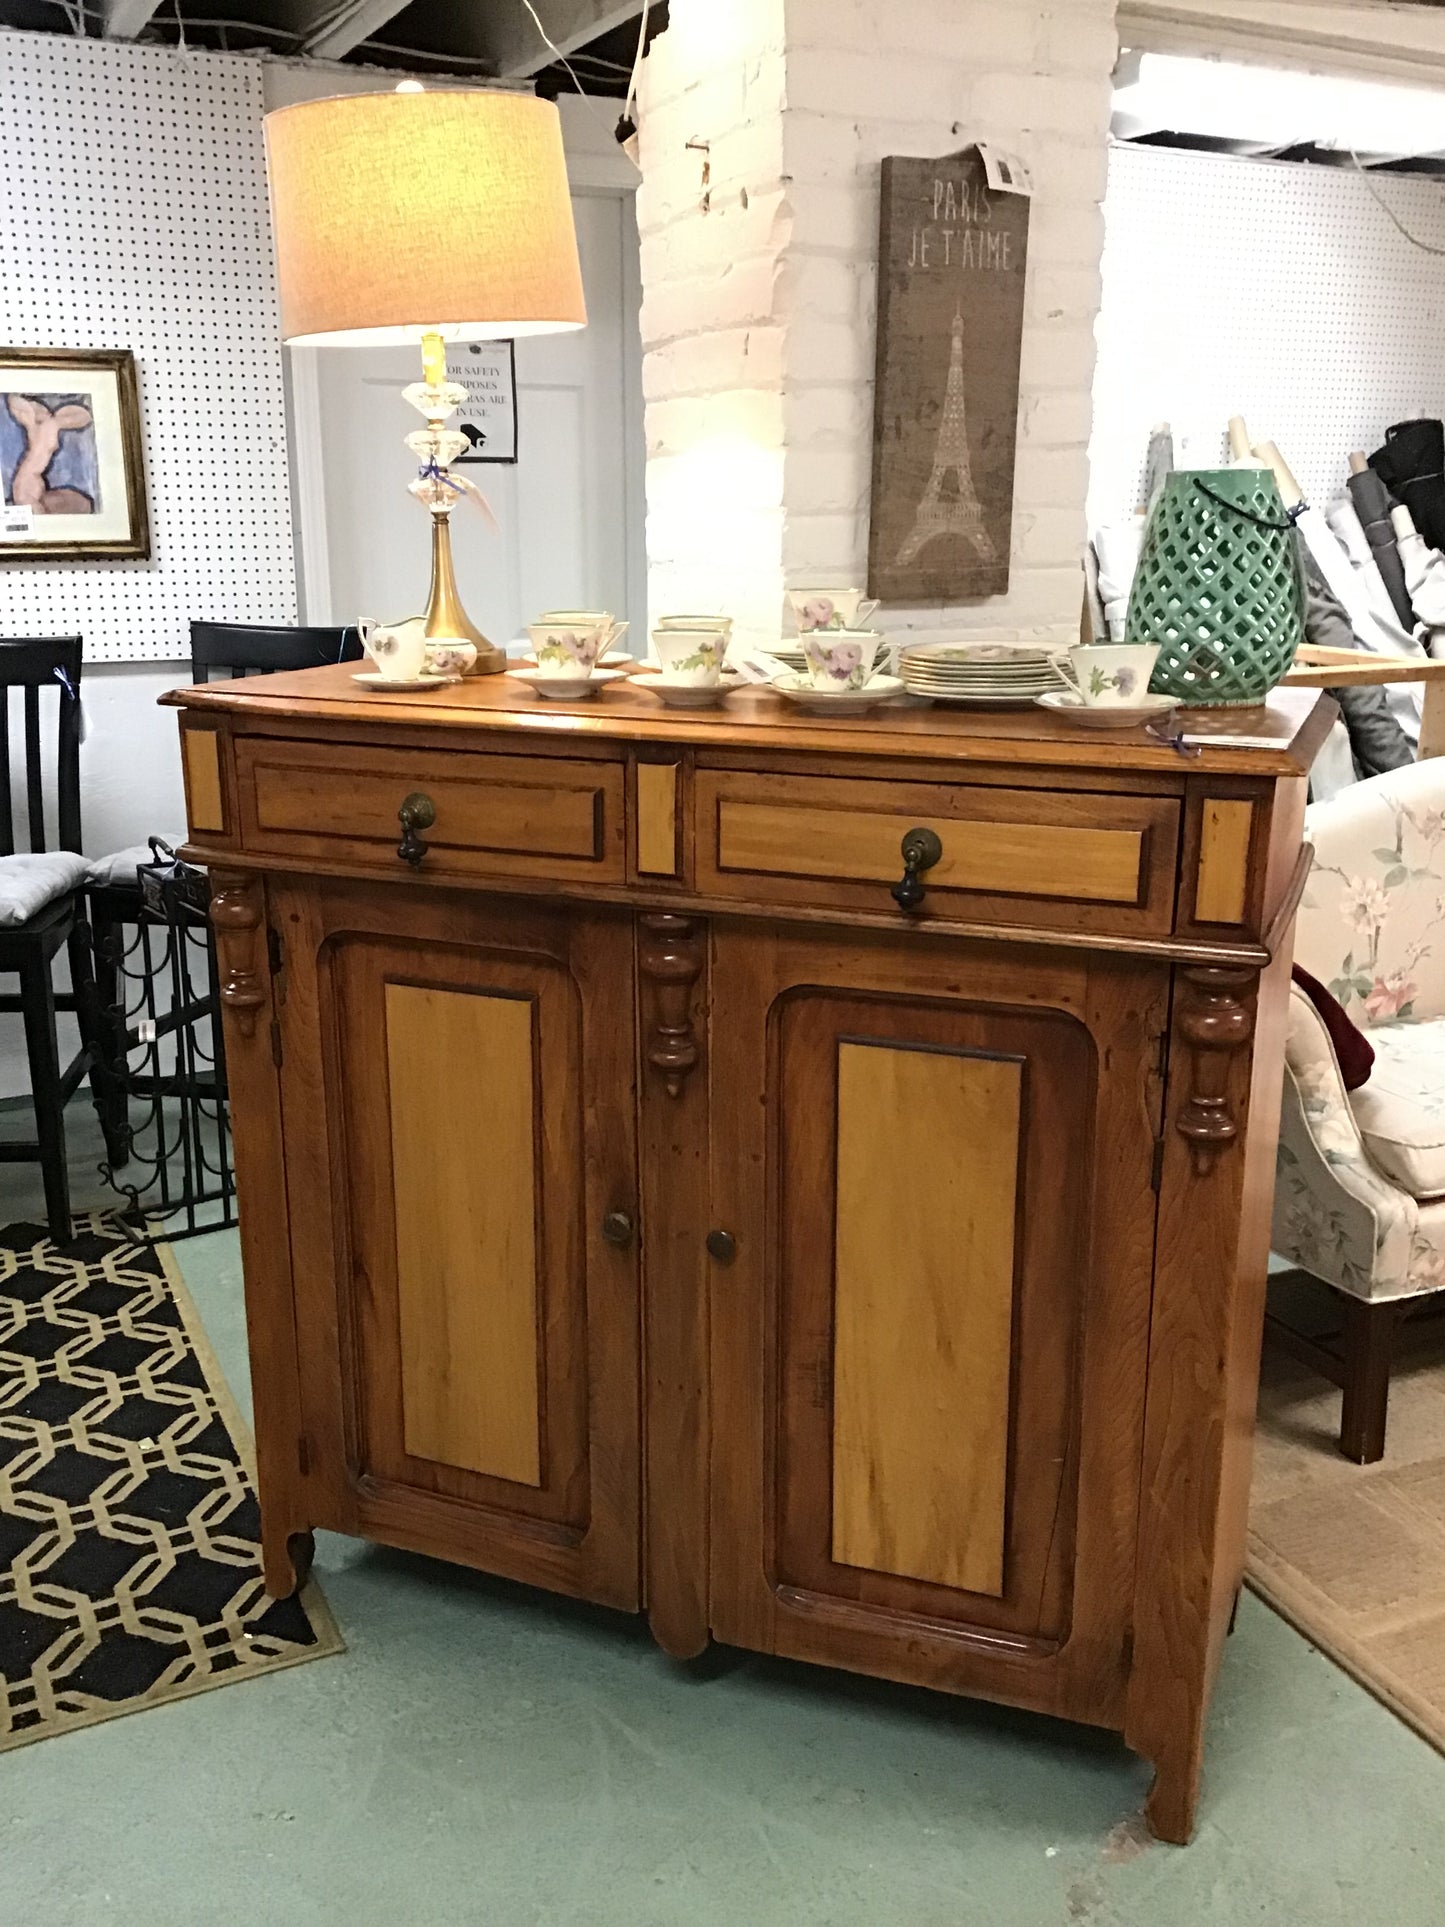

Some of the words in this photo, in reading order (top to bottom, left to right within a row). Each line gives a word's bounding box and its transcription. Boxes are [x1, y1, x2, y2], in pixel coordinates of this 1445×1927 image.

[933, 179, 992, 223] PARIS
[907, 227, 930, 268] JE
[942, 229, 1011, 271] T'AIME
[447, 366, 462, 375] OR
[464, 367, 500, 376] SAFETY
[490, 395, 506, 404] ARE
[456, 407, 467, 416] IN
